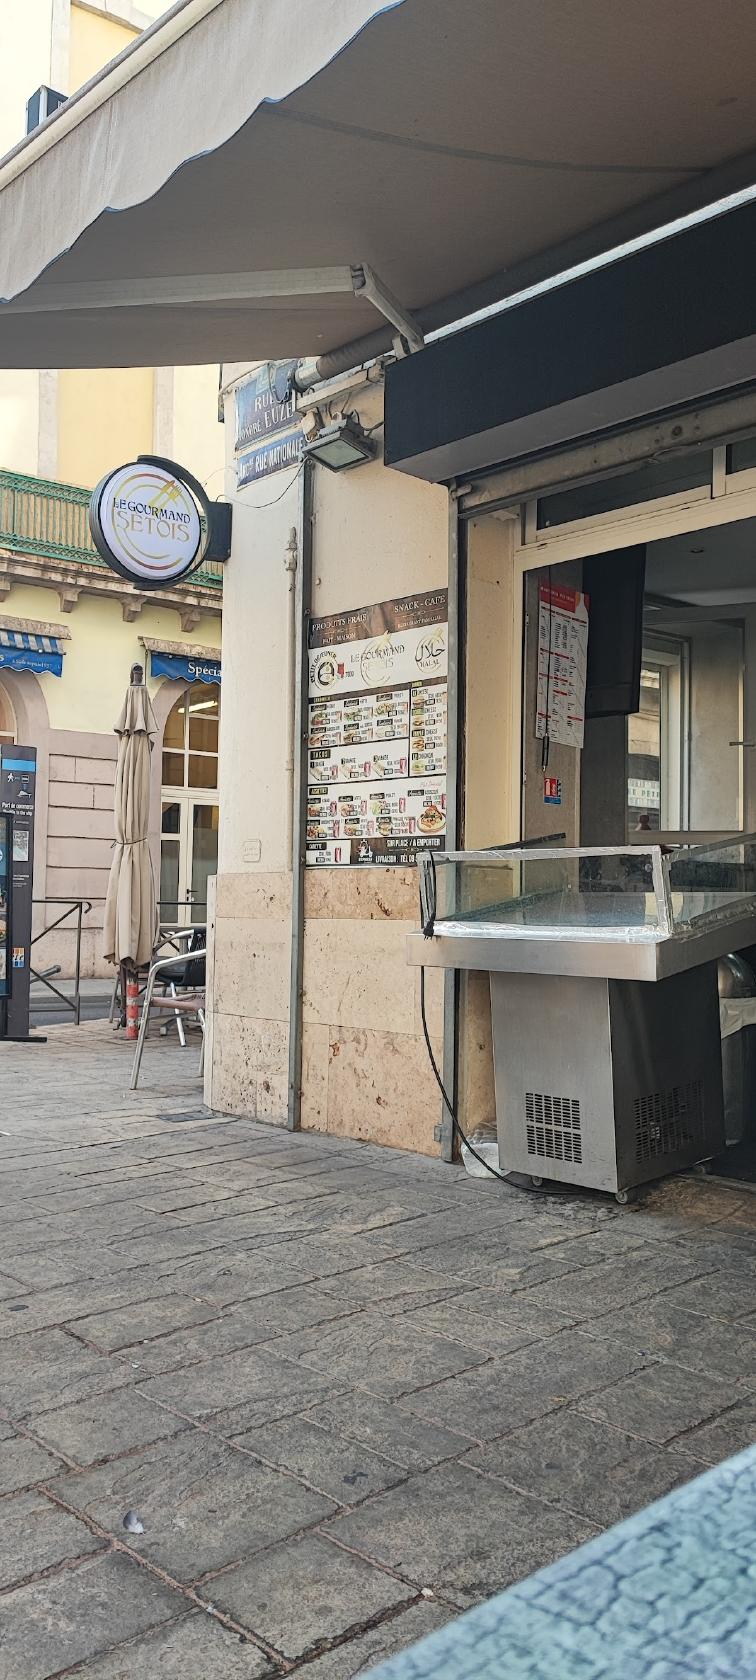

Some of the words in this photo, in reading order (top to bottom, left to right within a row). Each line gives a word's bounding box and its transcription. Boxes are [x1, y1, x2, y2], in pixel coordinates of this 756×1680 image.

[255, 453, 267, 473] RUE
[268, 438, 304, 466] NATIONALE
[116, 510, 190, 542] SETOIS
[394, 600, 419, 613] SNACK
[312, 617, 347, 631] PRODUITS
[347, 613, 368, 624] FRAIS
[415, 643, 446, 662] حلال
[417, 838, 441, 847] EMPORTER
